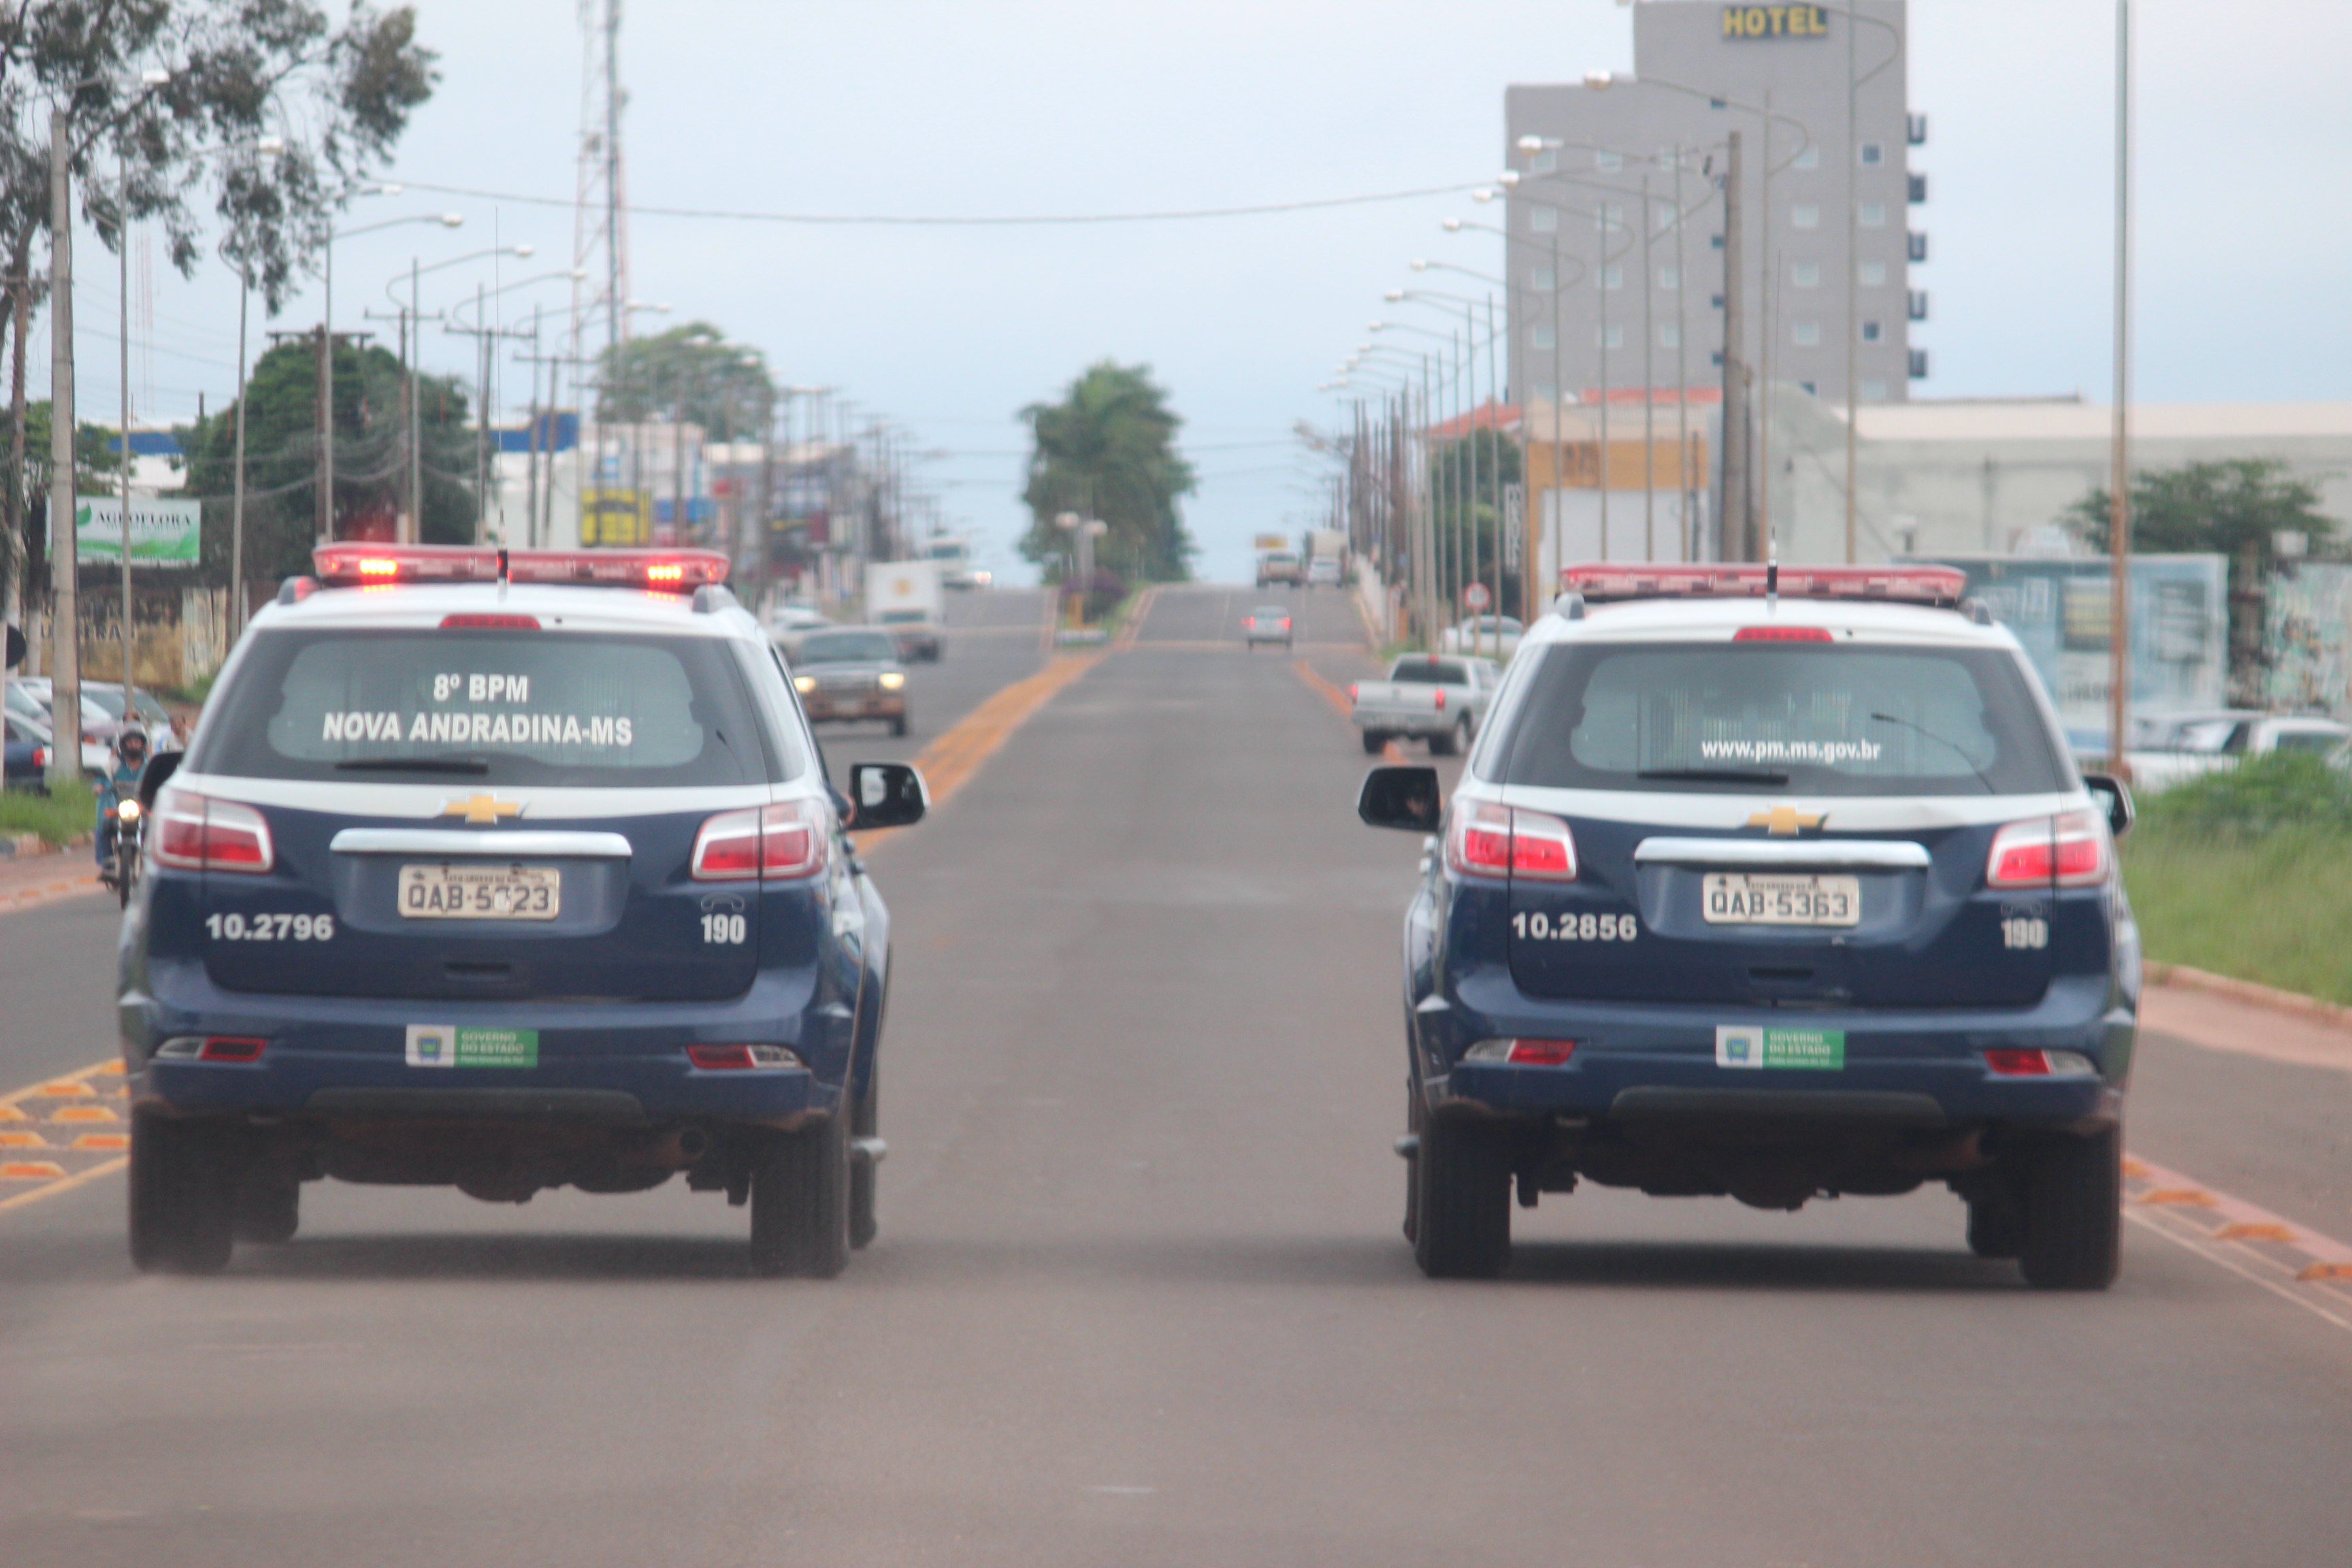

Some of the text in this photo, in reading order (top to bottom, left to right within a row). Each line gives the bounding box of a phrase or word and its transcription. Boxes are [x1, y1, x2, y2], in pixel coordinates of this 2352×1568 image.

[1723, 6, 1827, 35] HOTEL
[468, 674, 528, 703] BPM
[322, 711, 632, 747] NOVA ANDRADINA-MS
[1701, 737, 1881, 764] www.pm.ms.gov.br
[206, 913, 333, 941] 10.2796
[700, 913, 746, 945] 190
[1512, 911, 1637, 942] 10.2856
[2001, 917, 2048, 949] 190
[461, 1031, 517, 1042] GOVERNO
[461, 1043, 524, 1054] DO ESTADO
[1769, 1032, 1824, 1043] GOVERNO
[1769, 1044, 1831, 1056] DO ESTADO
